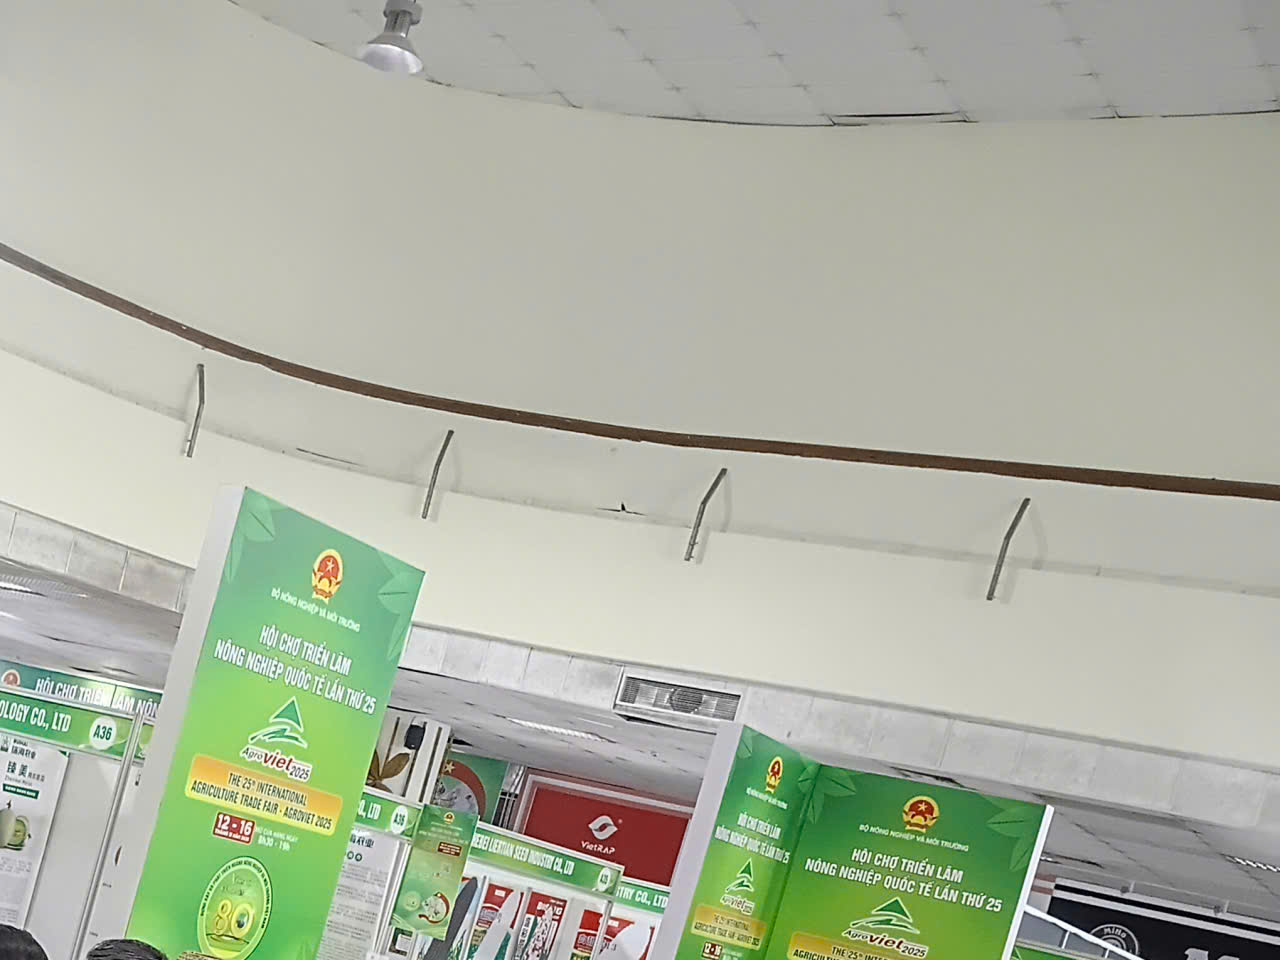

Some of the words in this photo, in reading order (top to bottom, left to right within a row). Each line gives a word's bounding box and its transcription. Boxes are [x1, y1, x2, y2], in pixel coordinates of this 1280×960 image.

[259, 624, 278, 651] HỘI
[279, 633, 302, 660] CHỢ
[301, 641, 330, 668] TRIỂN
[214, 638, 246, 666] NÔNG
[245, 651, 284, 682] NGHIỆP
[285, 664, 312, 691] QUỐC
[311, 674, 327, 696] TẾ
[344, 688, 367, 710] THỨ
[362, 697, 377, 715] 25
[52, 712, 72, 732] LTD
[94, 725, 112, 740] A36
[228, 772, 241, 787] THE
[256, 781, 308, 807] INTERNATIONAL
[191, 780, 239, 804] AGRICULTURE
[240, 794, 262, 811] TRADE
[262, 800, 279, 815] FAIR
[283, 806, 316, 826] AGROVIET
[315, 815, 332, 831] 2025
[217, 814, 231, 830] 12
[240, 820, 253, 836] 16
[581, 841, 615, 854] VietRAP
[851, 847, 871, 865] HỘI
[874, 852, 899, 871] CHỢ
[900, 857, 937, 877] TRIỂN
[936, 864, 964, 883] LÃM
[805, 857, 837, 876] NÔNG
[839, 864, 882, 887] NGHIỆP
[884, 873, 915, 893] QUỐC
[918, 880, 935, 896] TẾ
[960, 890, 988, 908] THỨ
[985, 898, 1003, 912] 25
[652, 894, 669, 908] LTD
[831, 946, 847, 958] THE
